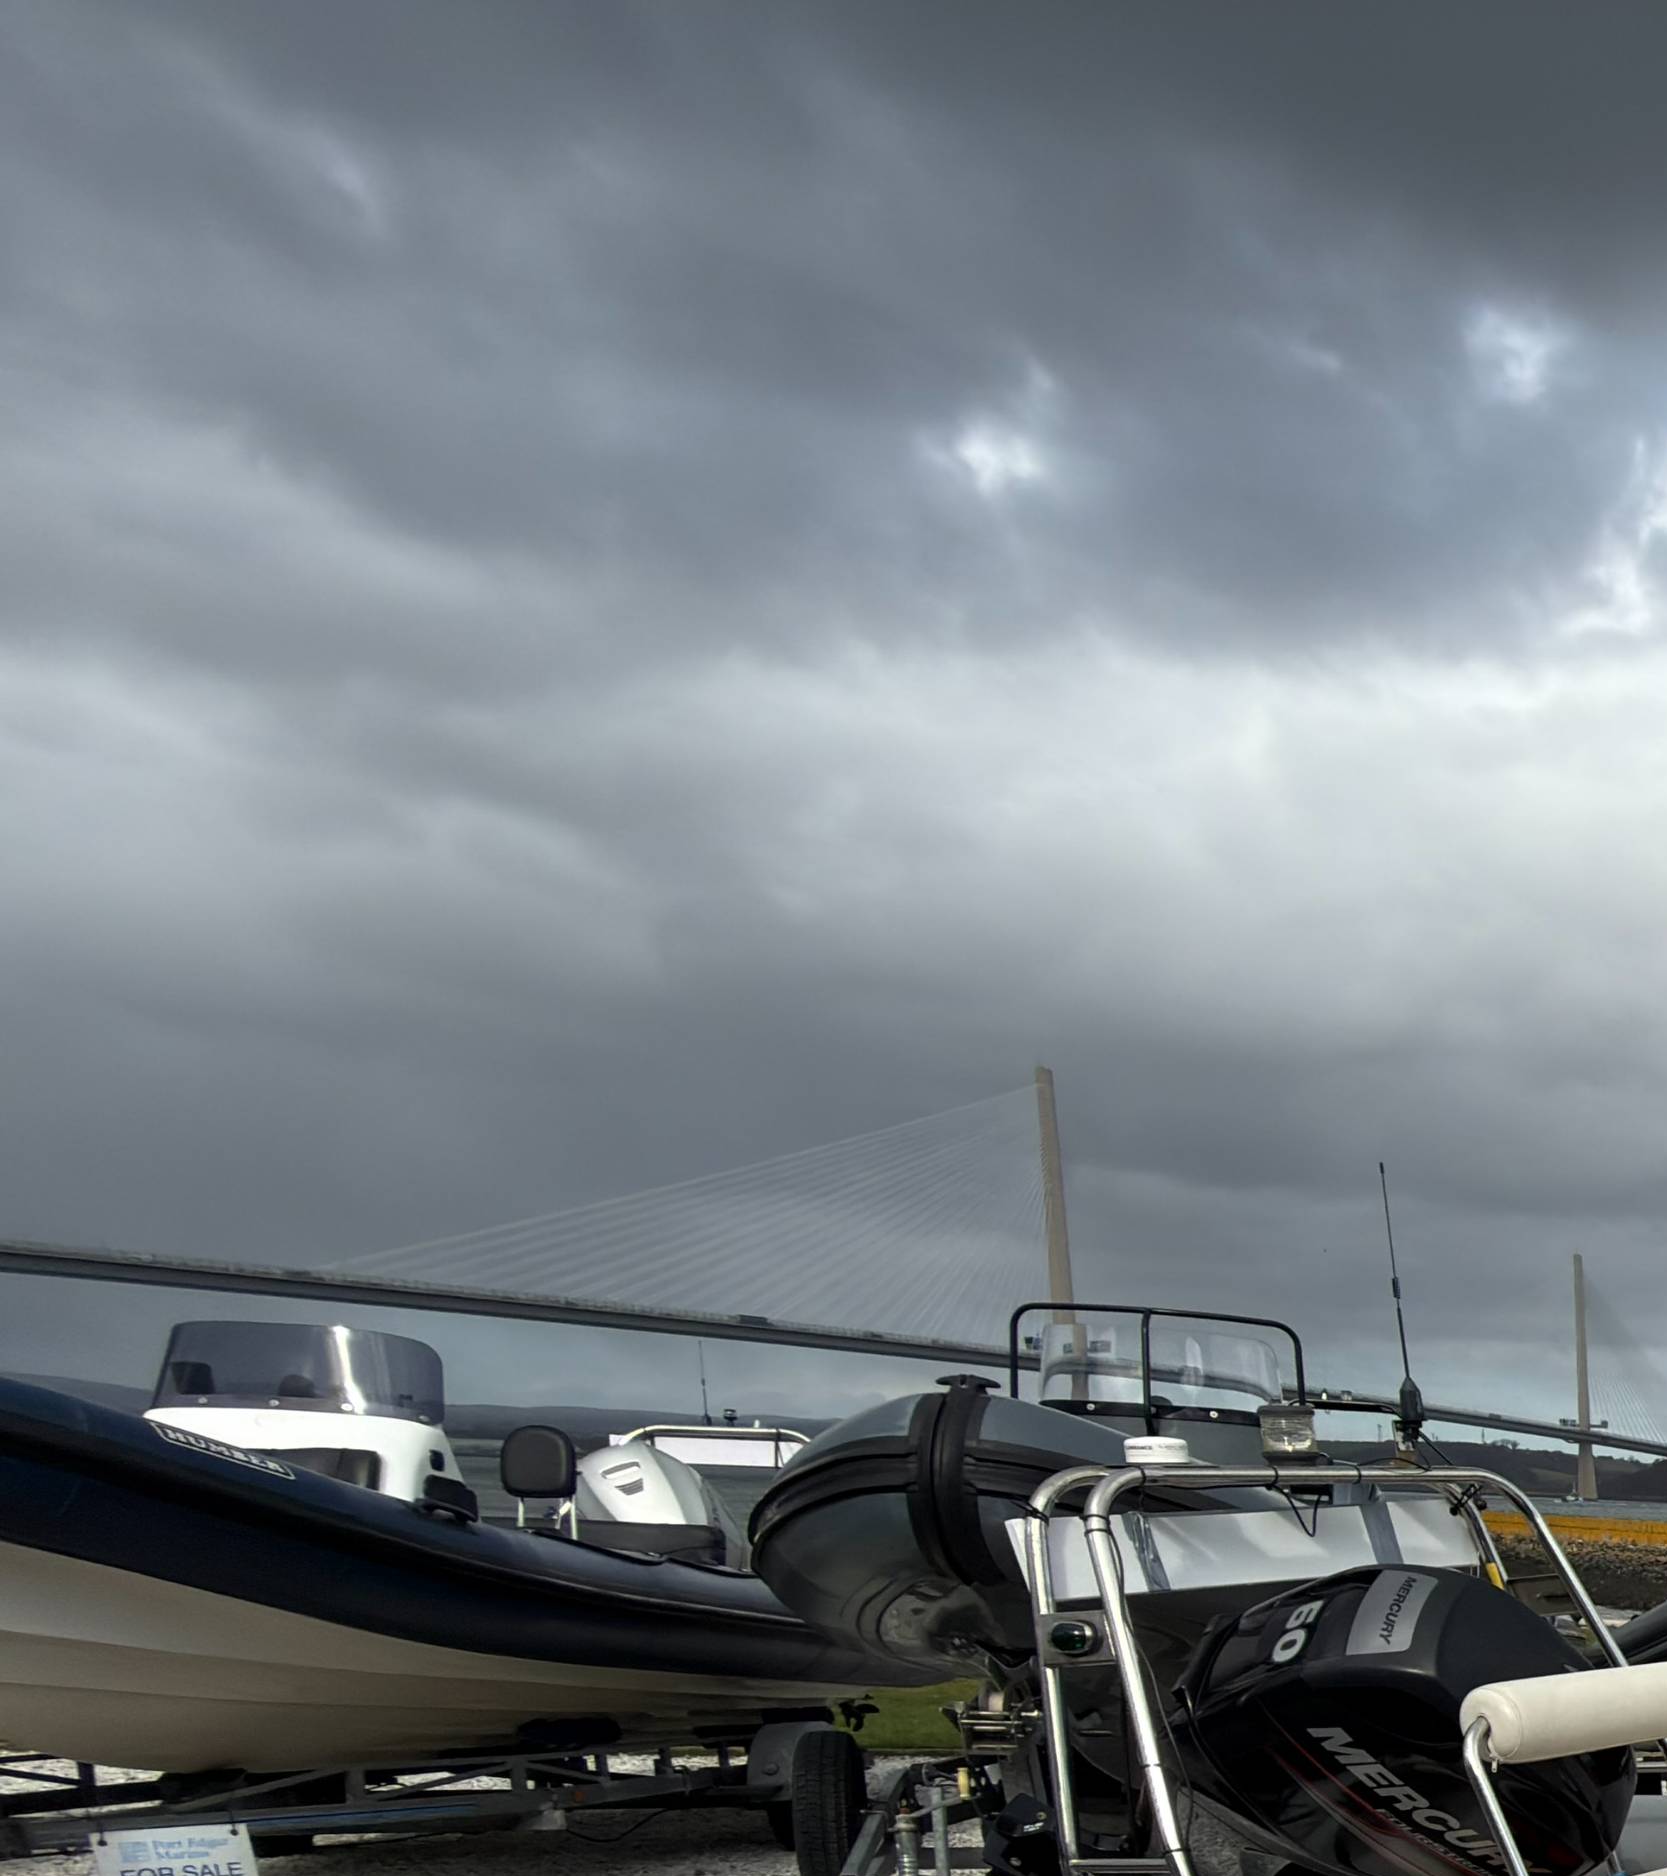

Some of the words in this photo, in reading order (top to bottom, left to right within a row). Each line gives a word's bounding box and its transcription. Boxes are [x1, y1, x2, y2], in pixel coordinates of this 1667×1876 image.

[163, 1428, 286, 1473] HUMBER
[1271, 1600, 1325, 1664] 60
[1378, 1575, 1418, 1645] MERCURY
